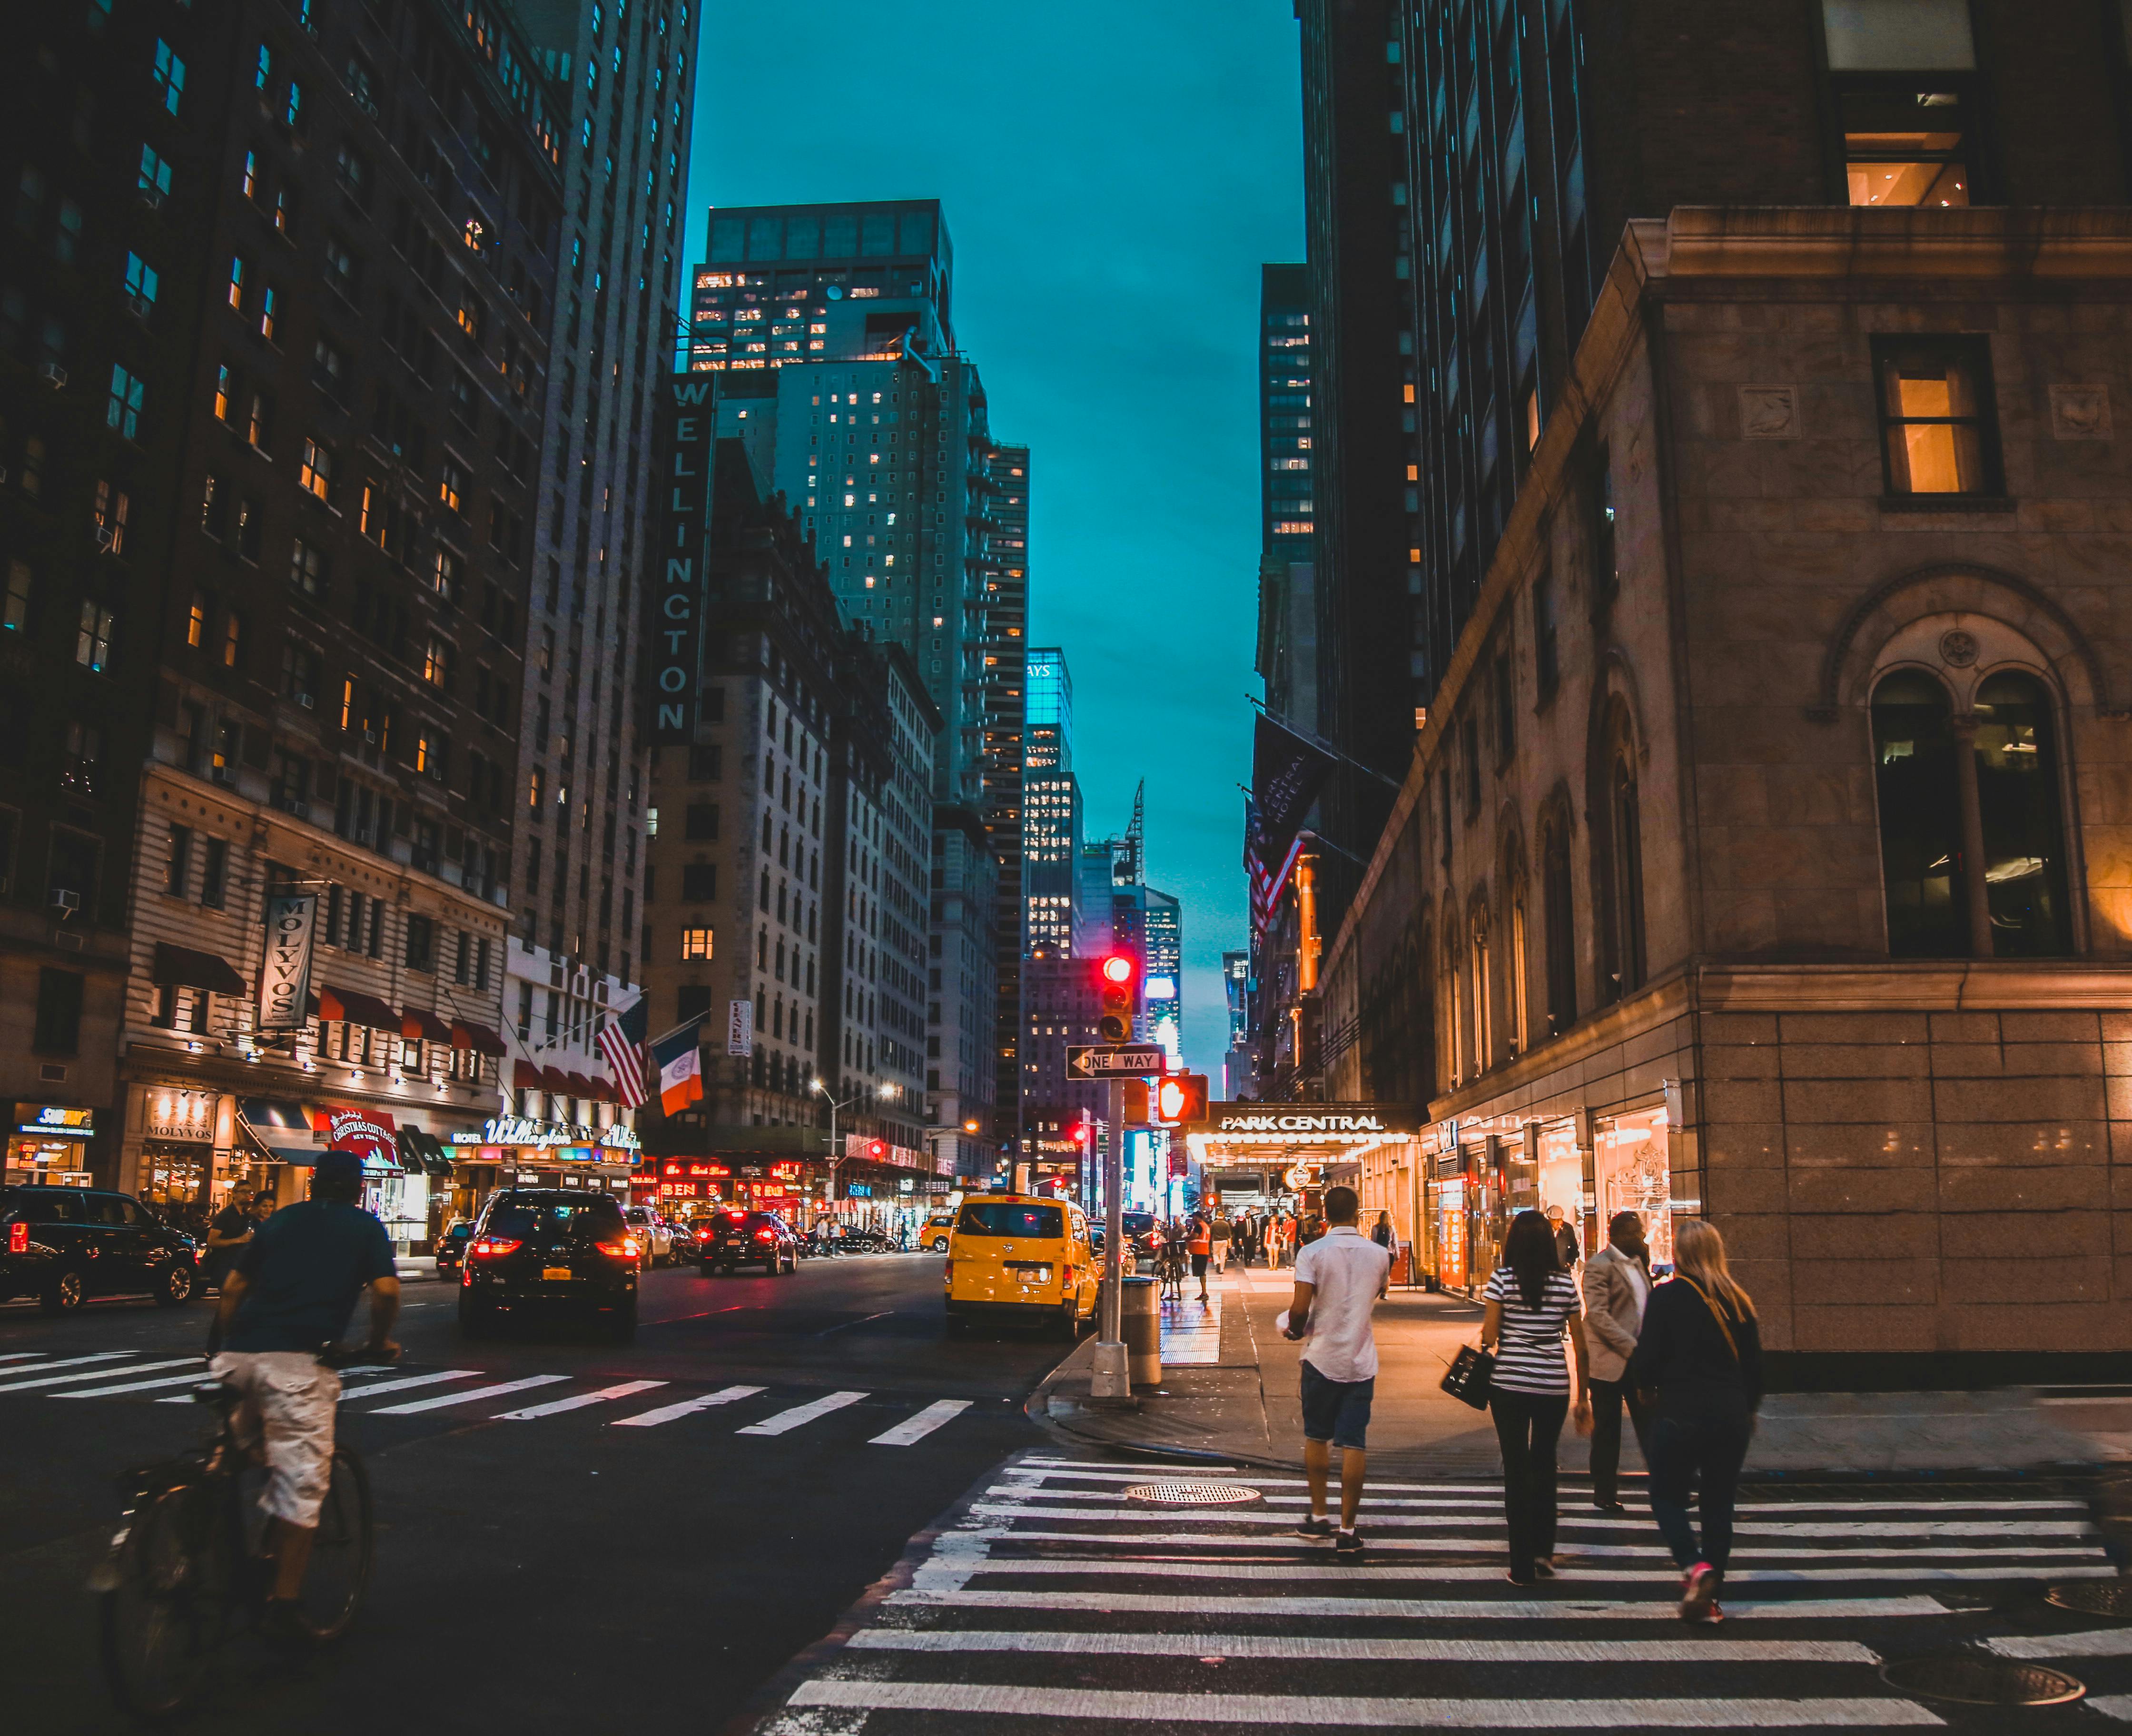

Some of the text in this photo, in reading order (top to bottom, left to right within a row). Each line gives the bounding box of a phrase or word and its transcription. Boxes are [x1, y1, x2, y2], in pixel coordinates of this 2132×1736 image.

[658, 383, 709, 729] WELLINGTON
[1027, 665, 1050, 676] AYS
[1267, 754, 1305, 816] CENTRAL
[1274, 779, 1303, 823] HOTEL
[272, 901, 306, 1013] MOLYVOS
[1084, 1055, 1153, 1068] ONE WAY
[147, 1125, 212, 1139] MOLYVOS
[334, 1122, 396, 1147] CHRISTMAS COTTAGE
[451, 1119, 572, 1151] HOTEL Wellington
[1222, 1116, 1384, 1130] PARK CENTRAL
[661, 1184, 696, 1196] BEN
